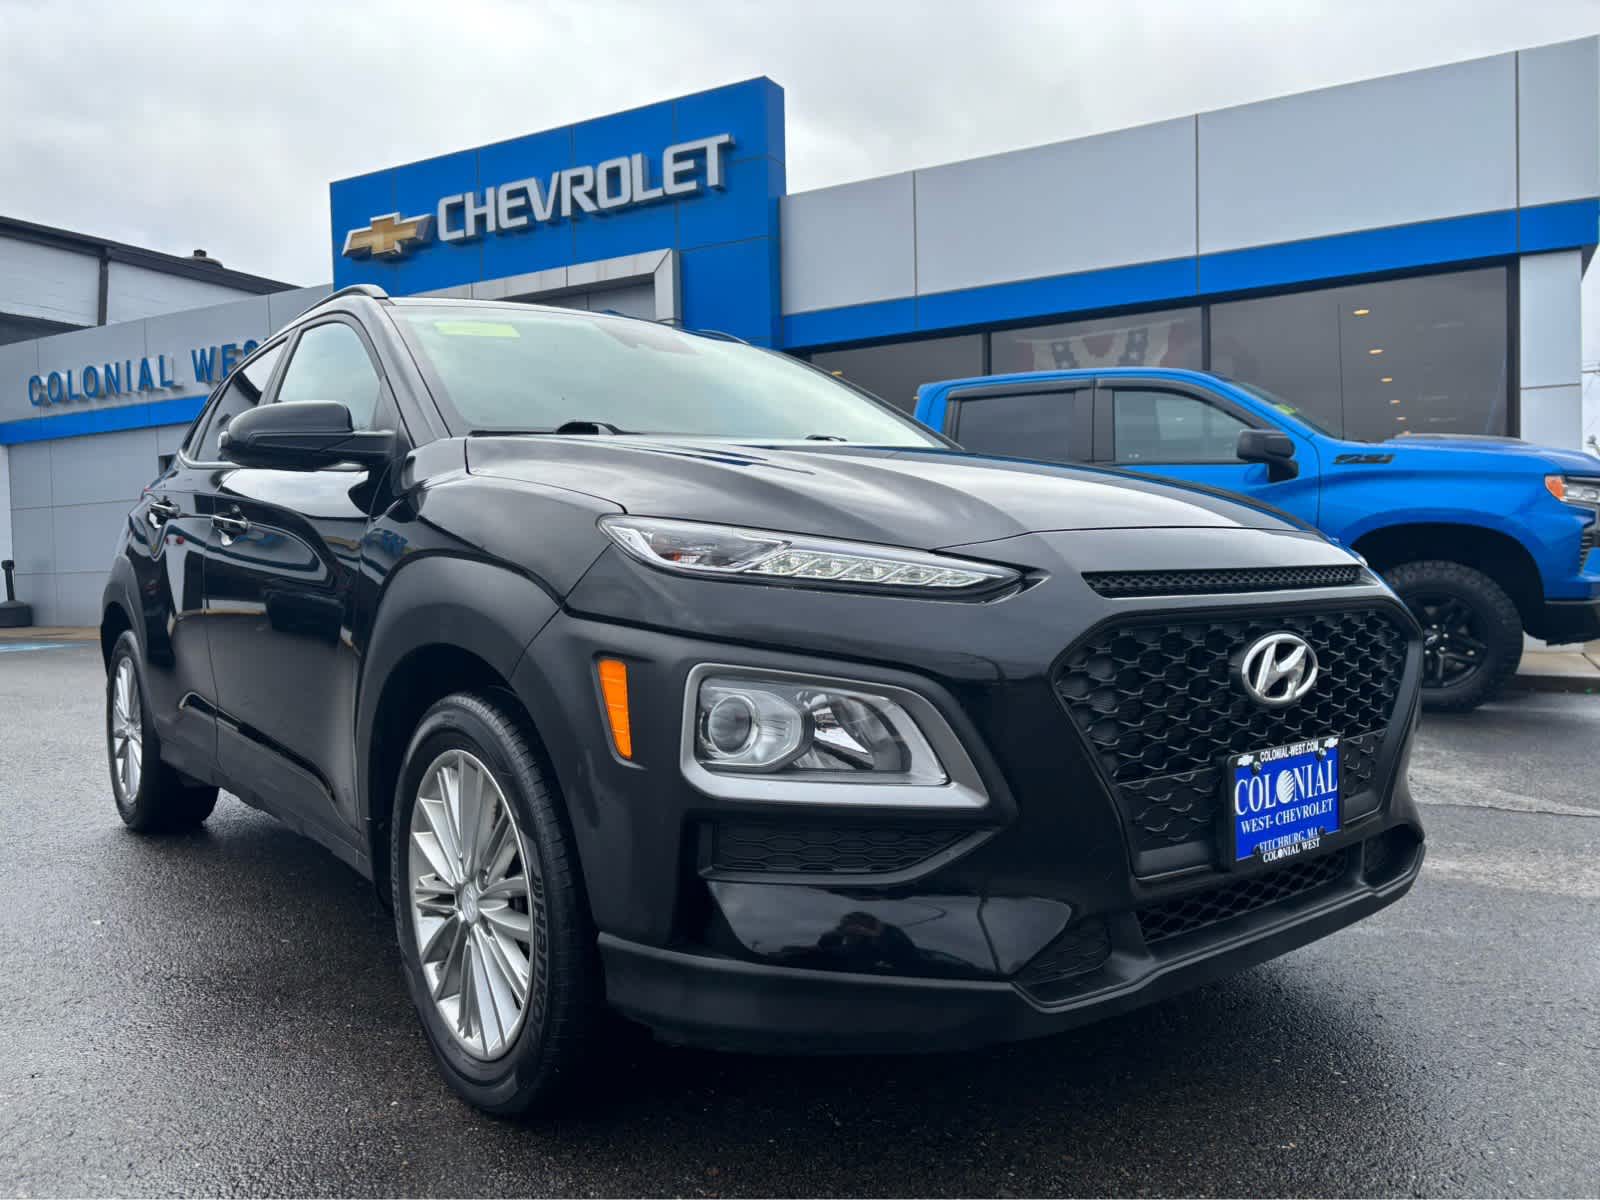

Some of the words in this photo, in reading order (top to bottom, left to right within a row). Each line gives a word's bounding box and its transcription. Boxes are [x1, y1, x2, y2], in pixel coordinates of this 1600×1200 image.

[437, 133, 734, 243] CHEVROLET
[28, 353, 176, 407] COLONIAL
[191, 337, 269, 383] WES
[1234, 759, 1338, 816] COLONIAL
[1276, 798, 1334, 825] CHEVROLET
[1262, 846, 1300, 863] COLONIAL
[1303, 838, 1320, 850] WEST
[1307, 827, 1318, 838] MA
[528, 903, 547, 1051] Hankoo
